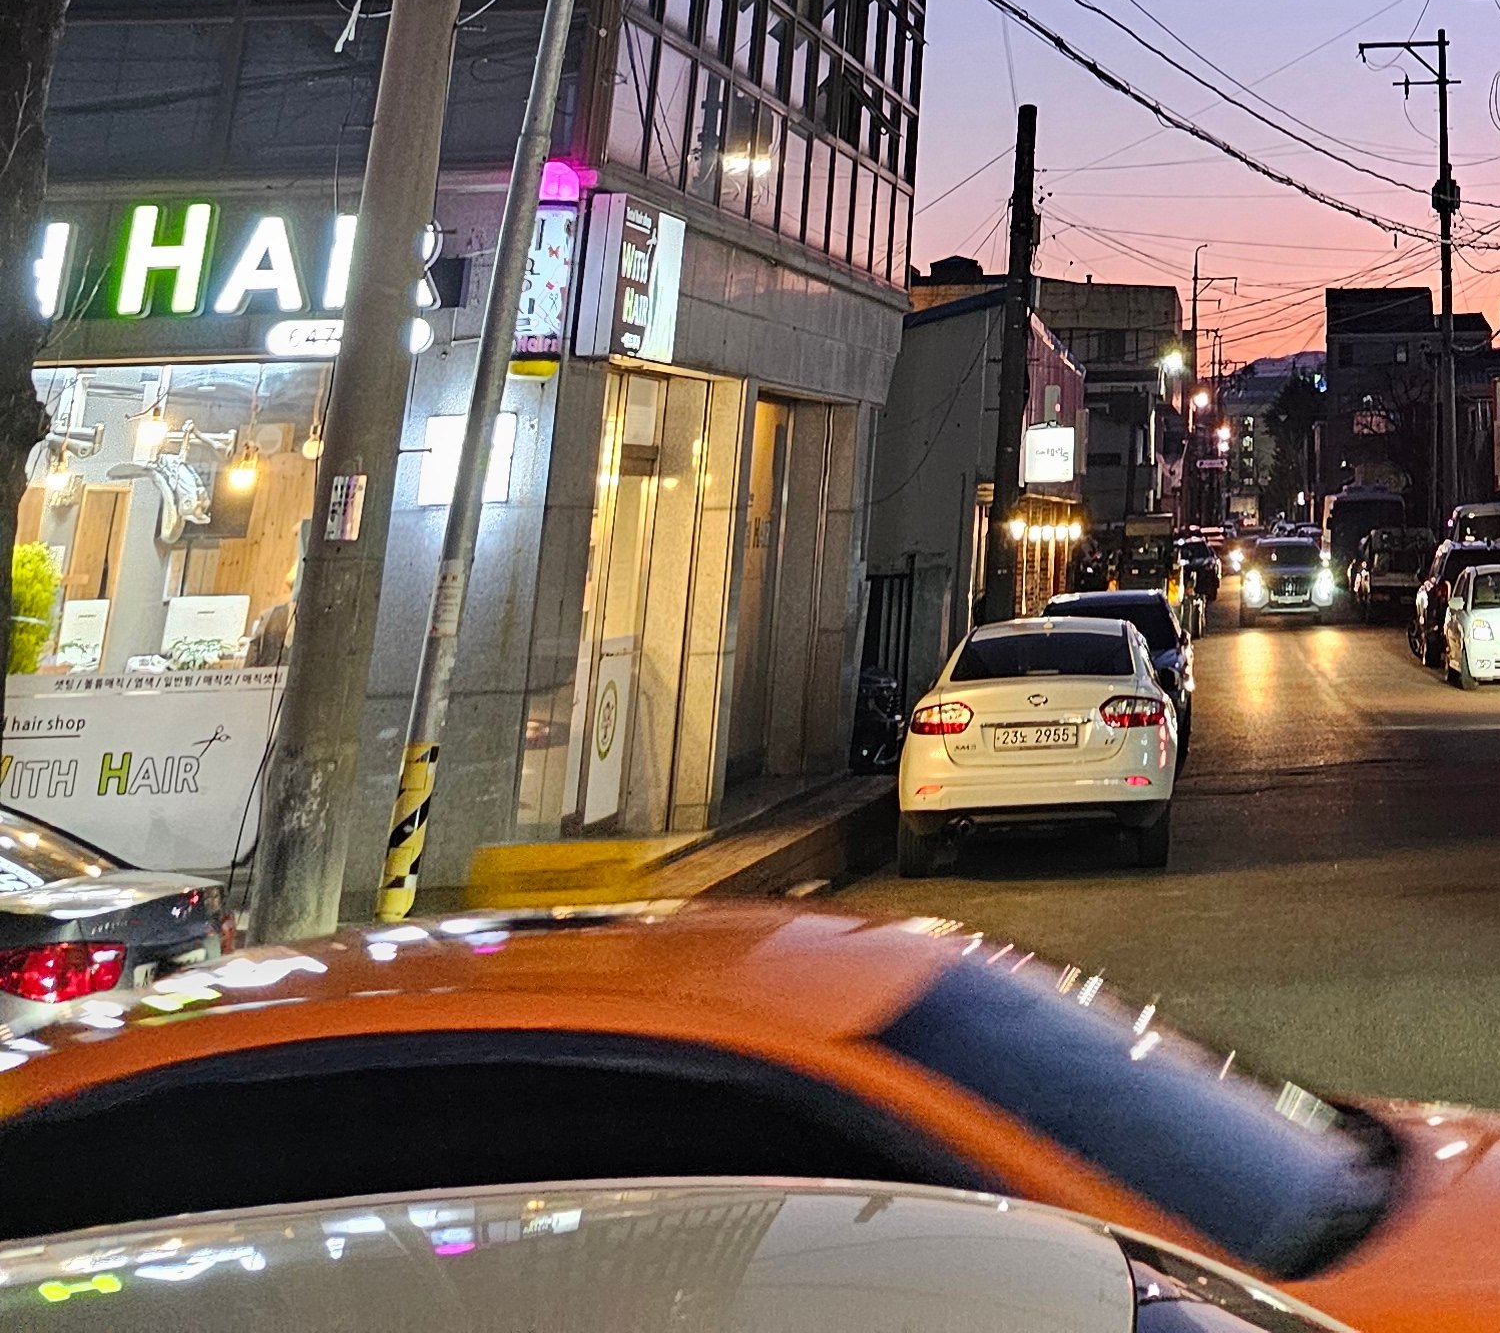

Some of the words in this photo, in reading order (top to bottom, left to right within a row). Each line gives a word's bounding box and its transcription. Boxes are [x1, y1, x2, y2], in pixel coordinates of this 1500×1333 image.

[11, 715, 45, 732] hair
[47, 714, 86, 734] shop
[1035, 729, 1070, 744] 2955
[97, 751, 201, 796] HAIR
